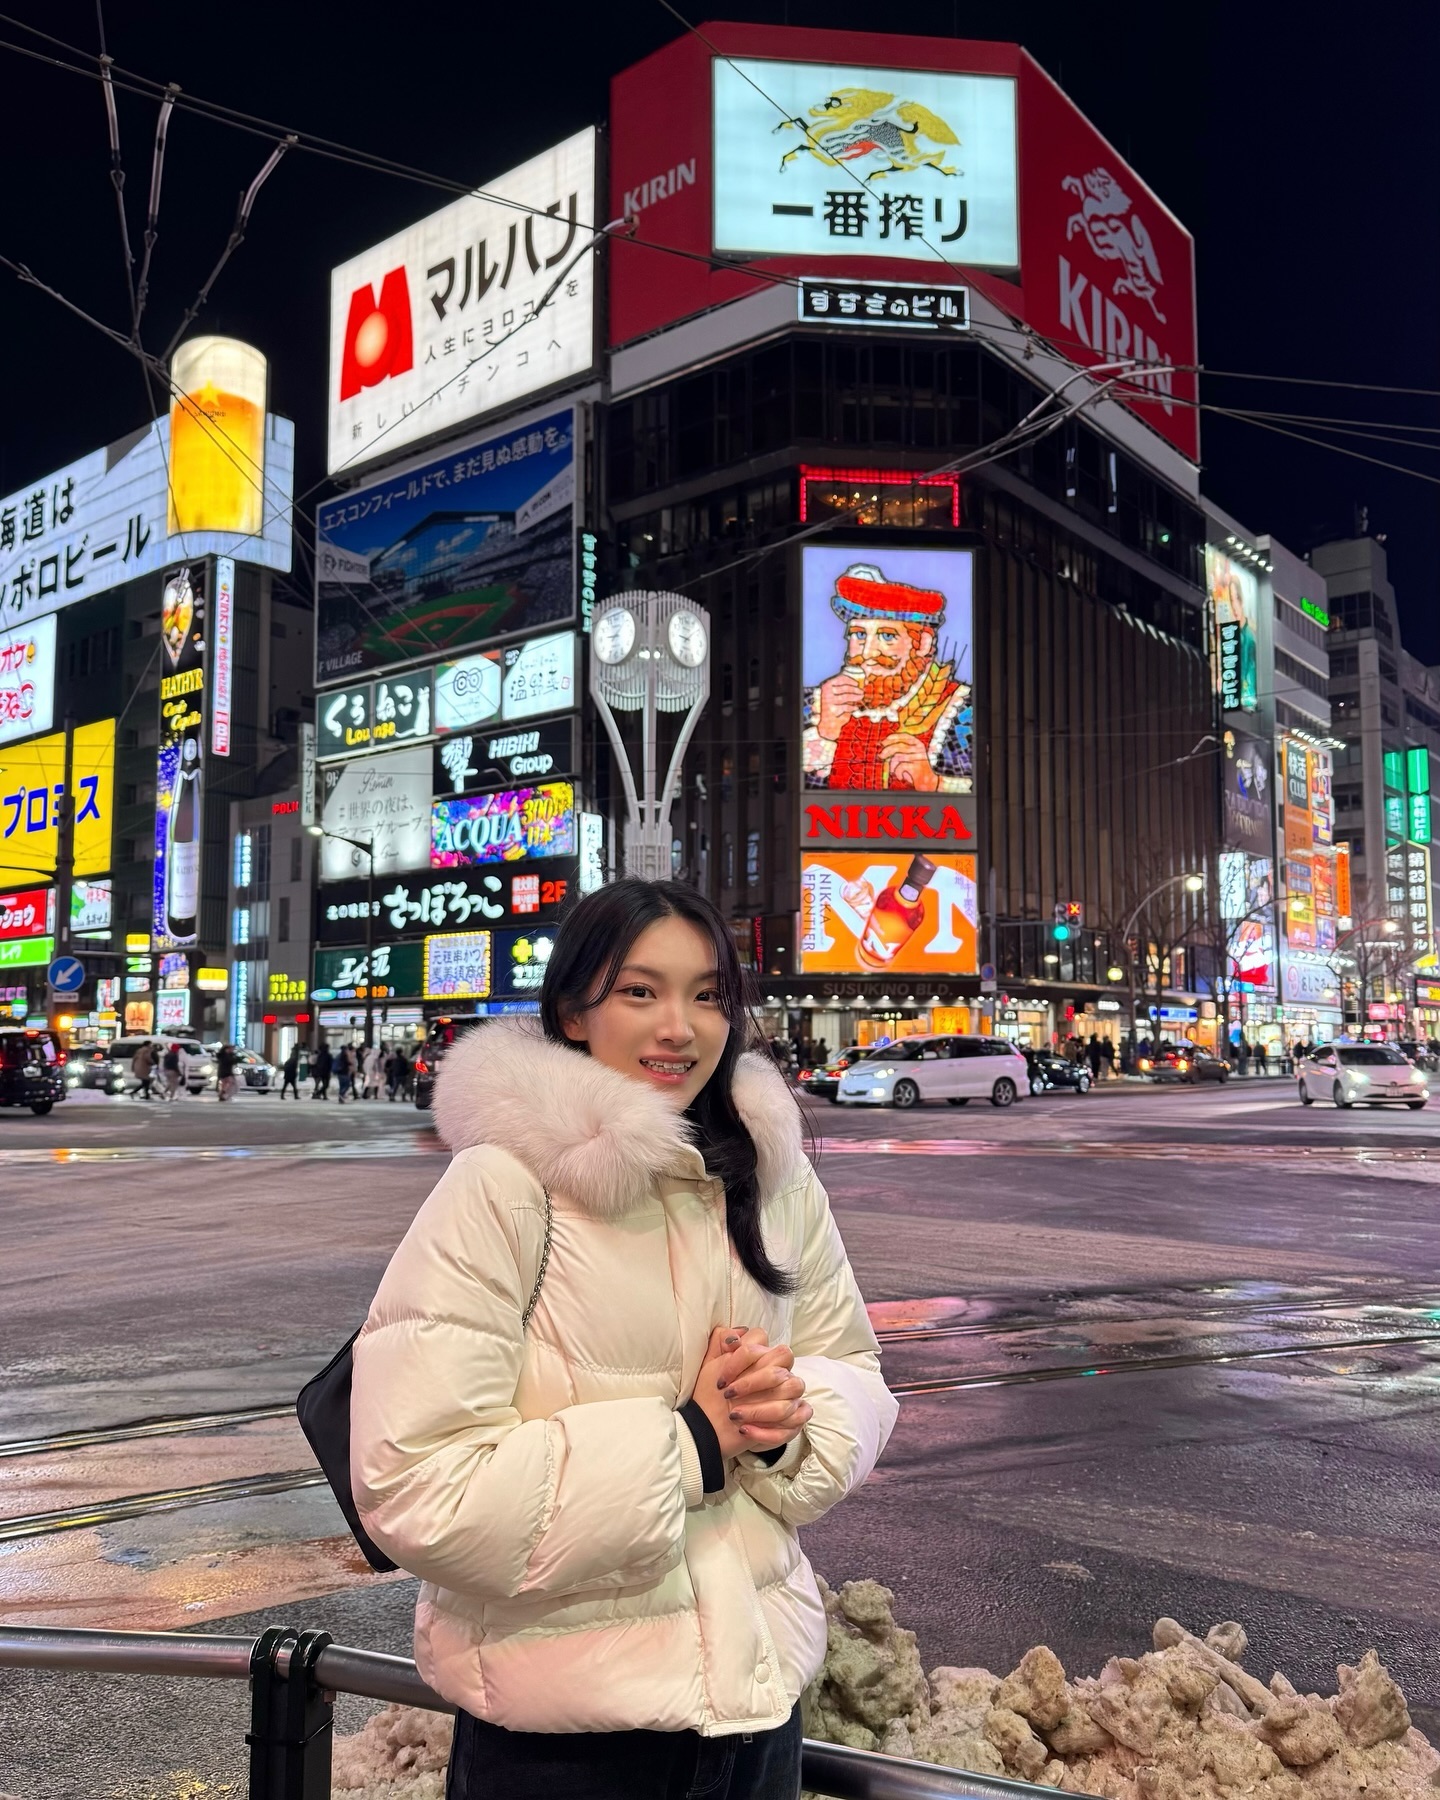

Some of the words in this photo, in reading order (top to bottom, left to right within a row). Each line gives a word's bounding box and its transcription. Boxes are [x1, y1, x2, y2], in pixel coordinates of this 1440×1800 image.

[623, 157, 697, 218] KIRIN
[773, 191, 969, 242] 一番搾り
[426, 191, 578, 322] マルハン
[1058, 254, 1173, 417] KIRIN
[323, 426, 567, 531] エスコンフィールドで、まだ見ぬ感動を。
[0, 513, 151, 612] ポロビール
[326, 651, 363, 672] VILLAGE
[346, 721, 396, 746] Lounge
[488, 731, 540, 759] HIBIKI
[510, 753, 554, 776] Group
[438, 811, 522, 853] ACQUA
[804, 804, 974, 840] NIKKA
[541, 880, 567, 903] 2F
[803, 873, 816, 951] FRONTIER
[819, 873, 832, 925] NIKKA
[1408, 852, 1429, 951] 第23桂和ビル
[822, 982, 910, 997] SUSUKINO
[915, 983, 954, 997] BLD.
